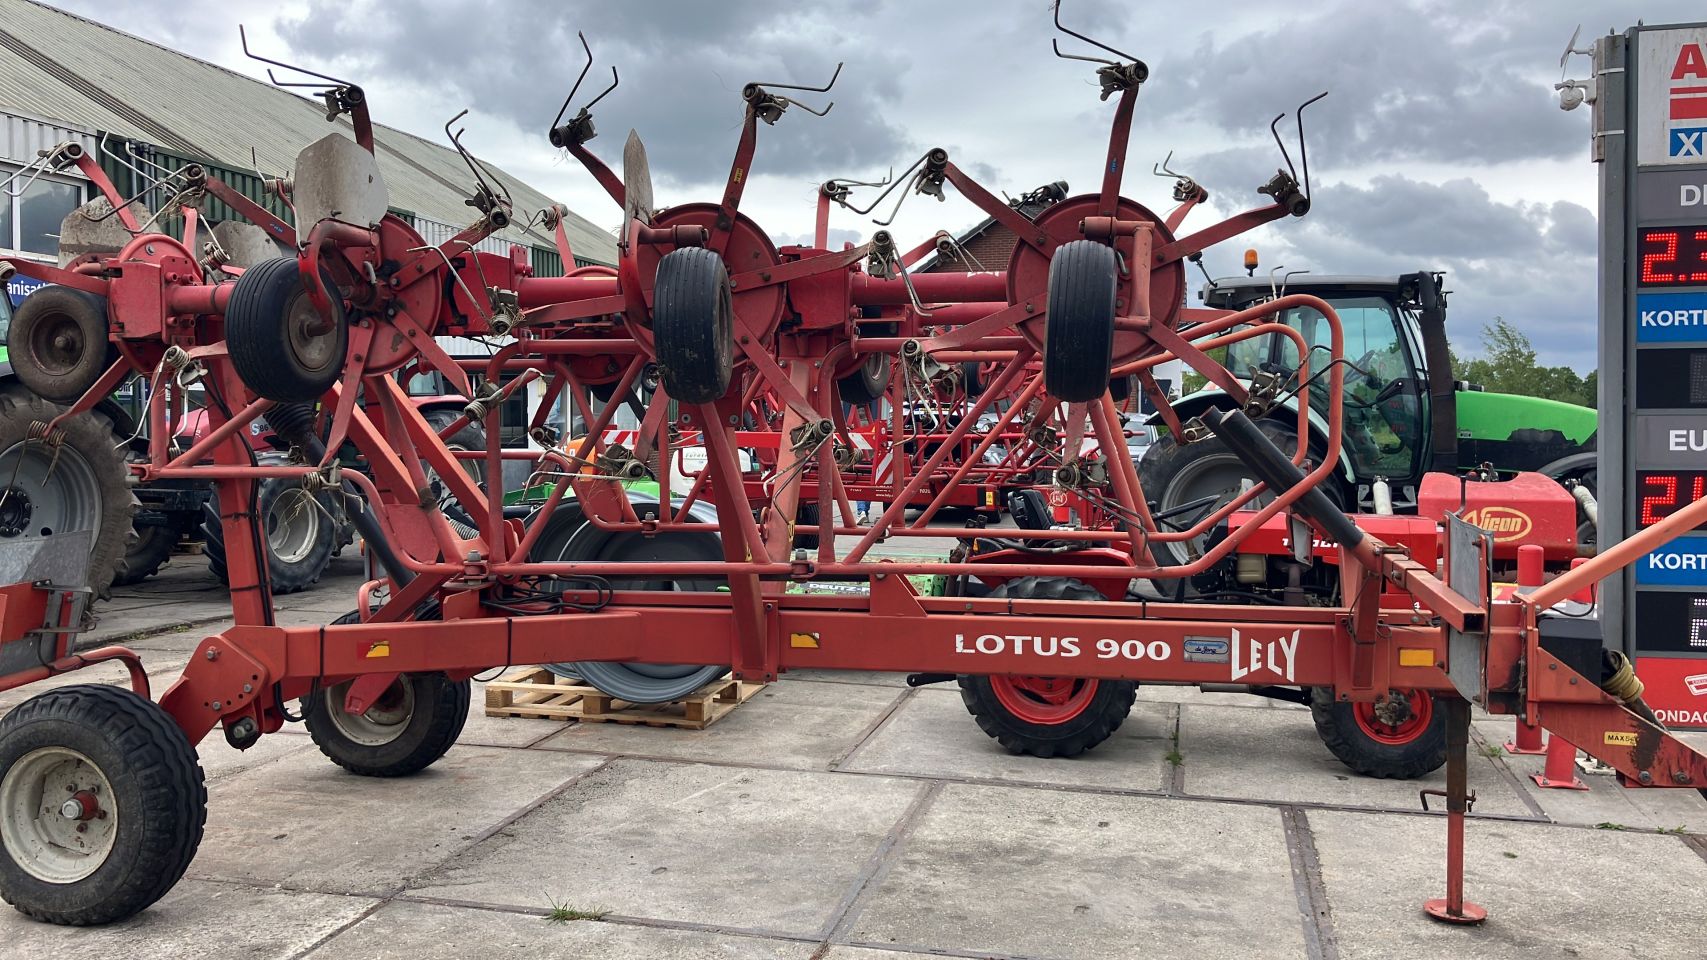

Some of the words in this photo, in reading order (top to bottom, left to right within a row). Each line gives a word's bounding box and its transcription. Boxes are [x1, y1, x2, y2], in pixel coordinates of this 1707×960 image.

[955, 633, 1081, 657] LOTUS
[1096, 638, 1171, 661] 900
[1231, 627, 1300, 683] LELY
